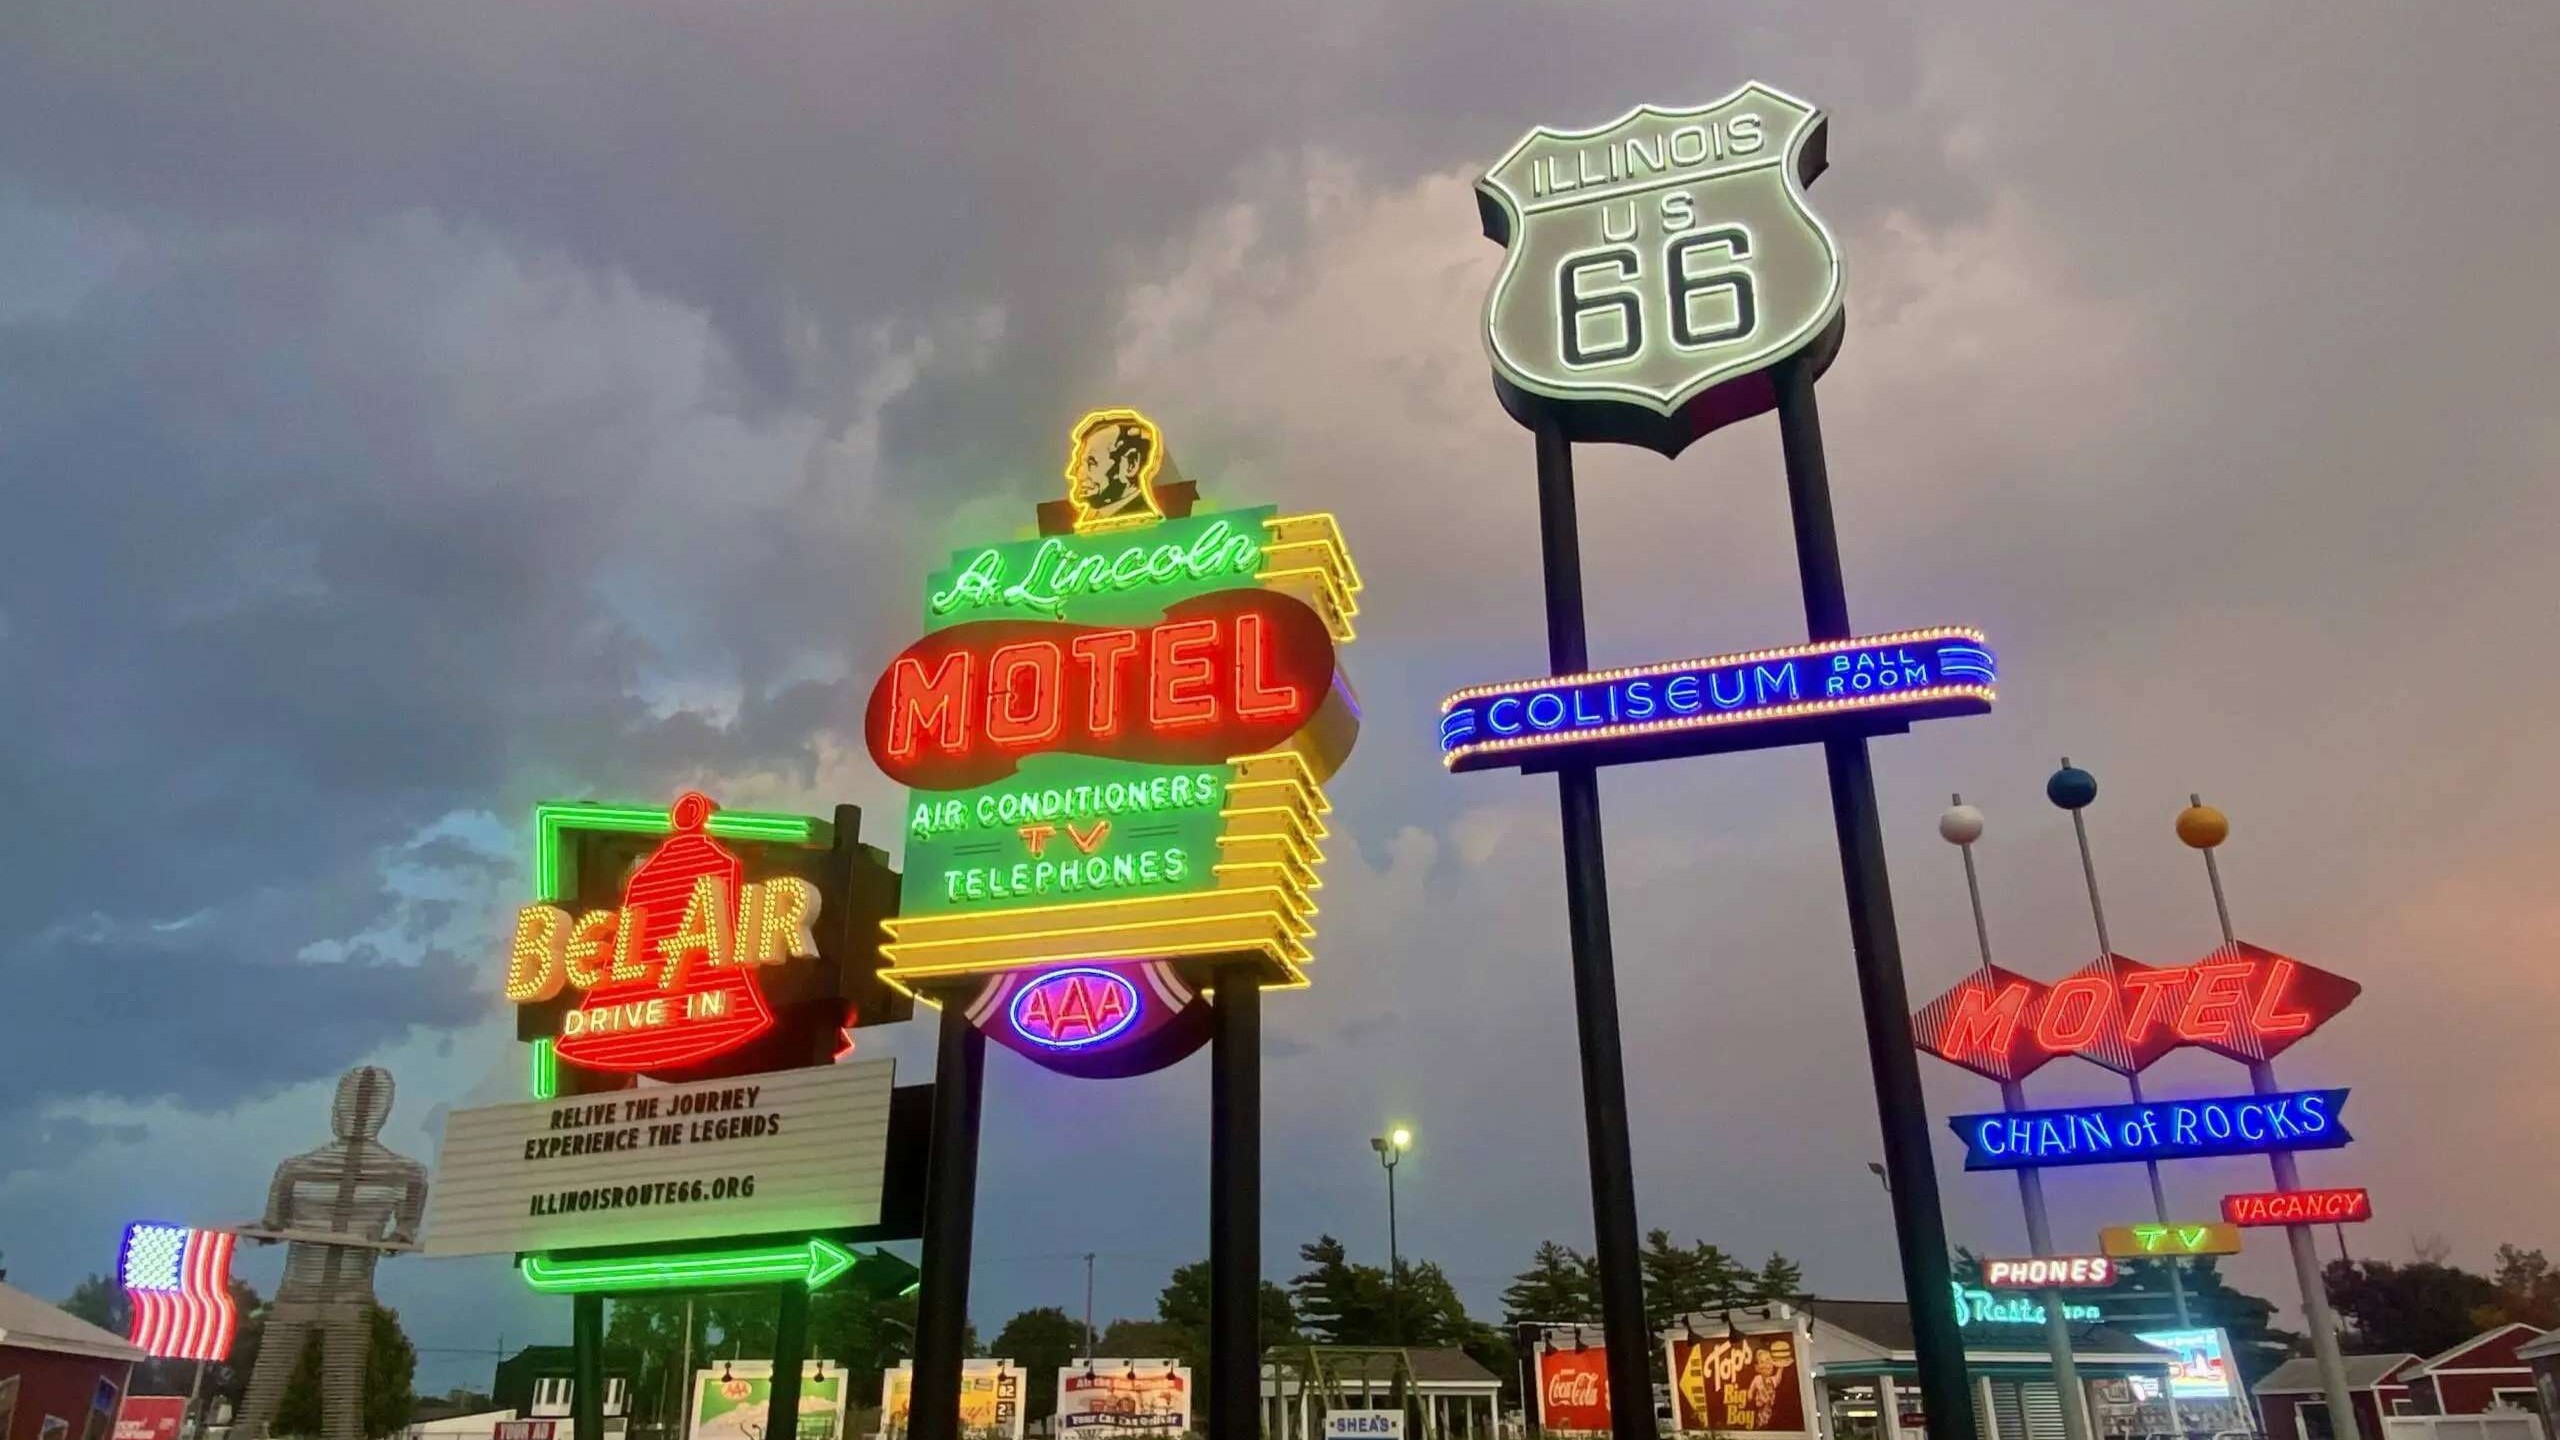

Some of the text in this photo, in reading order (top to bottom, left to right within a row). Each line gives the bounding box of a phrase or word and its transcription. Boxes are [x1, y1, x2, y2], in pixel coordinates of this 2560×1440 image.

[1532, 112, 1764, 198] ILLINOIS
[1555, 221, 1760, 371] 66
[1003, 519, 1262, 620] Lincoln
[887, 613, 1298, 757] MOTEL
[1826, 663, 1929, 697] ROOM
[1833, 648, 1915, 674] BALL
[1487, 661, 1798, 736] COLISEUM
[911, 772, 1220, 838] AIR CONDITIONERS
[945, 846, 1189, 902] TELEPHONES
[655, 873, 812, 989] AIR
[564, 989, 727, 1036] DRIVE IN
[1020, 975, 1128, 1040] AAA
[1943, 960, 2309, 1061] MOTEL
[551, 1086, 760, 1130] RELIVE THE JOURNEY
[1979, 1096, 2328, 1156] CHAIN of ROCKS
[525, 1112, 781, 1160] EXPERIENCE THE LEGENDS
[530, 1175, 755, 1217] ILLINOISROUTE66.ORG
[2234, 1193, 2364, 1219] VACANCY
[1989, 1257, 2108, 1284] PHONES
[1704, 1339, 1753, 1392] Tops
[1723, 1383, 1749, 1409] Big
[1725, 1404, 1755, 1429] Boy
[1336, 1415, 1390, 1432] SHEA'S
